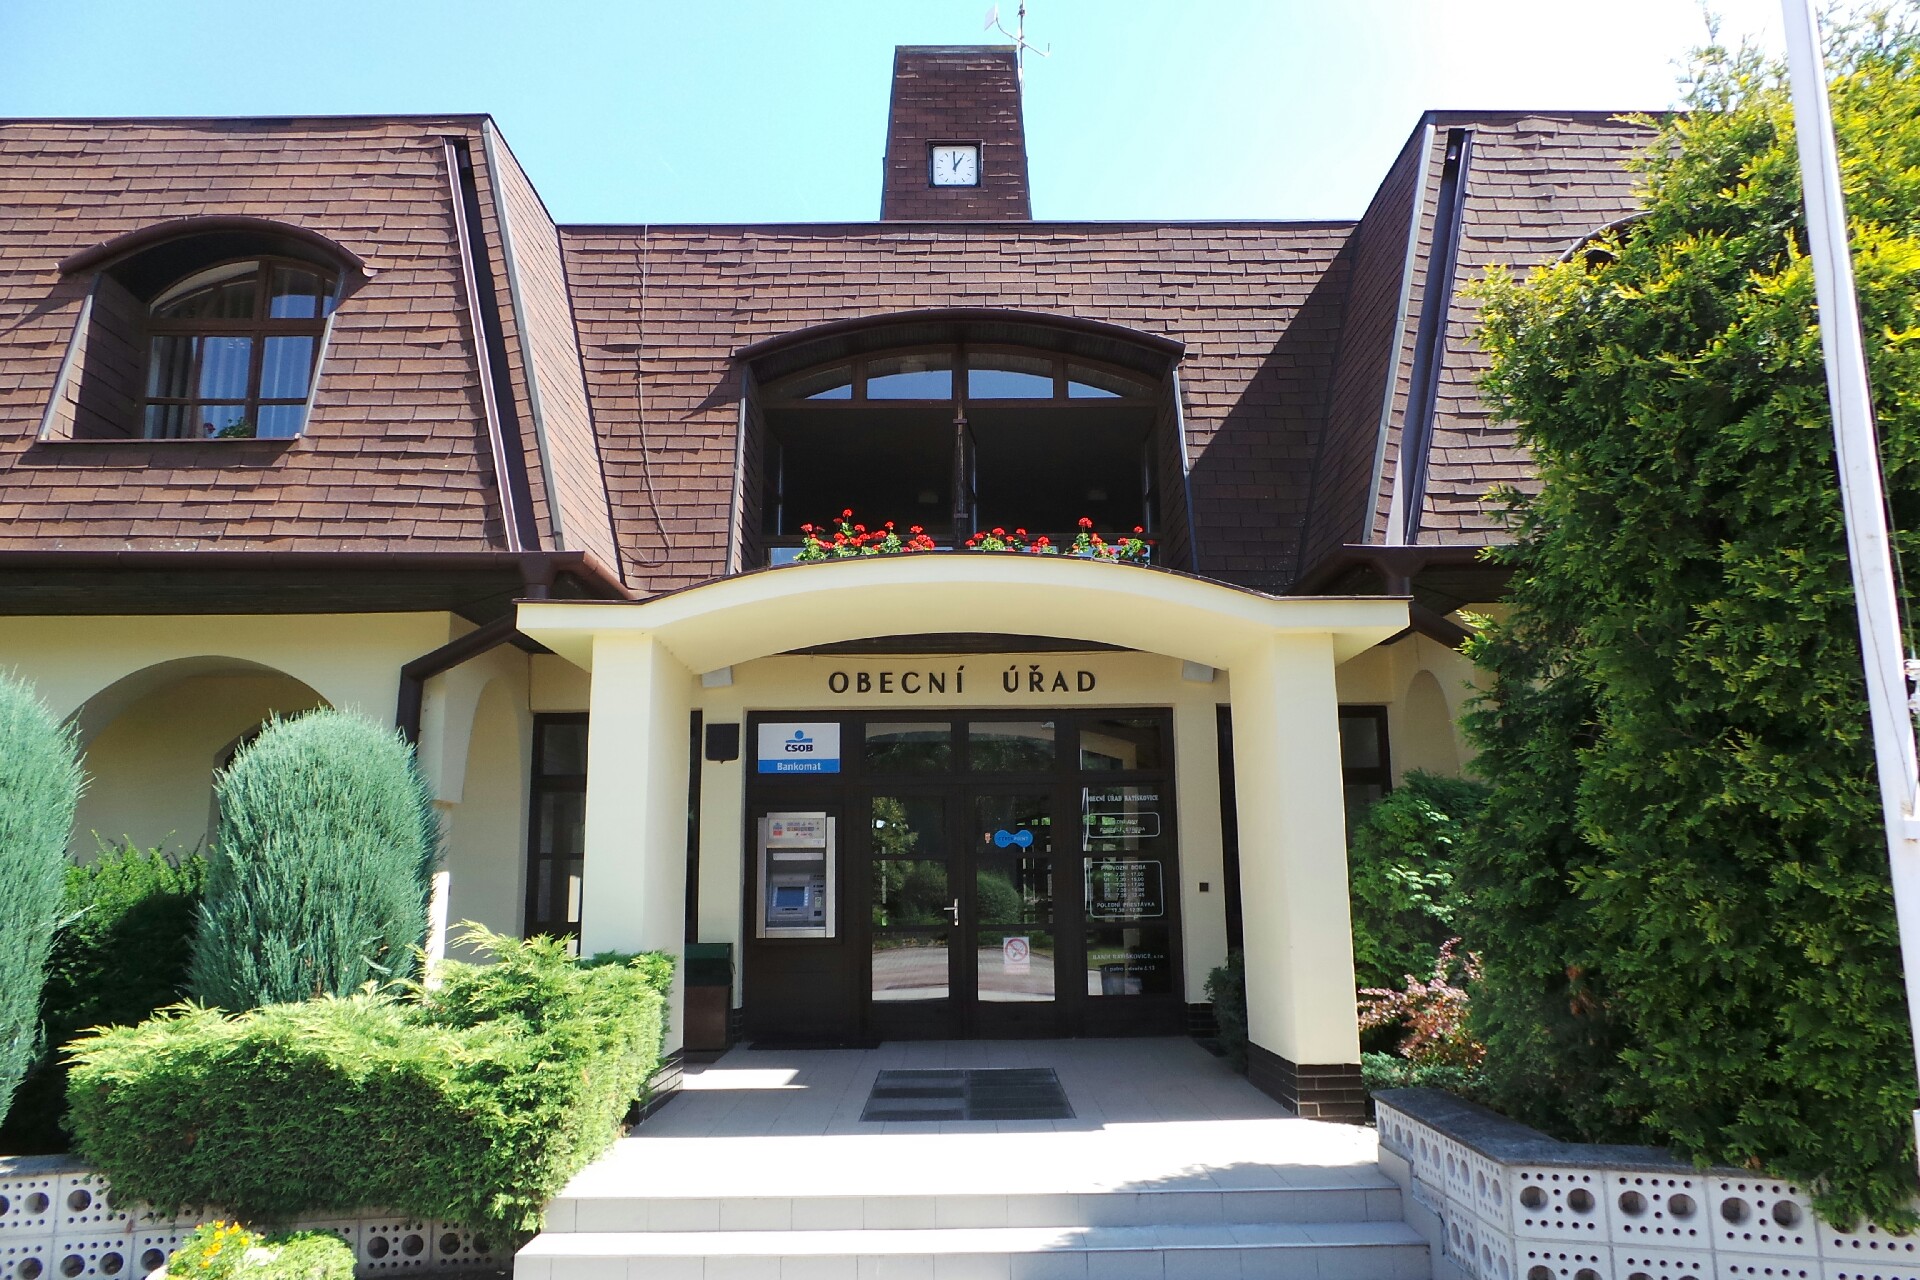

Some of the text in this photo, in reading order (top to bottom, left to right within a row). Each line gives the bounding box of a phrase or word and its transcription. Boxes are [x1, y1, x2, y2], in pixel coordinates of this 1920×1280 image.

[828, 664, 1096, 693] OBECNÍ ÚŘAD
[785, 743, 813, 752] ČSOB
[777, 762, 821, 771] Bankomat
